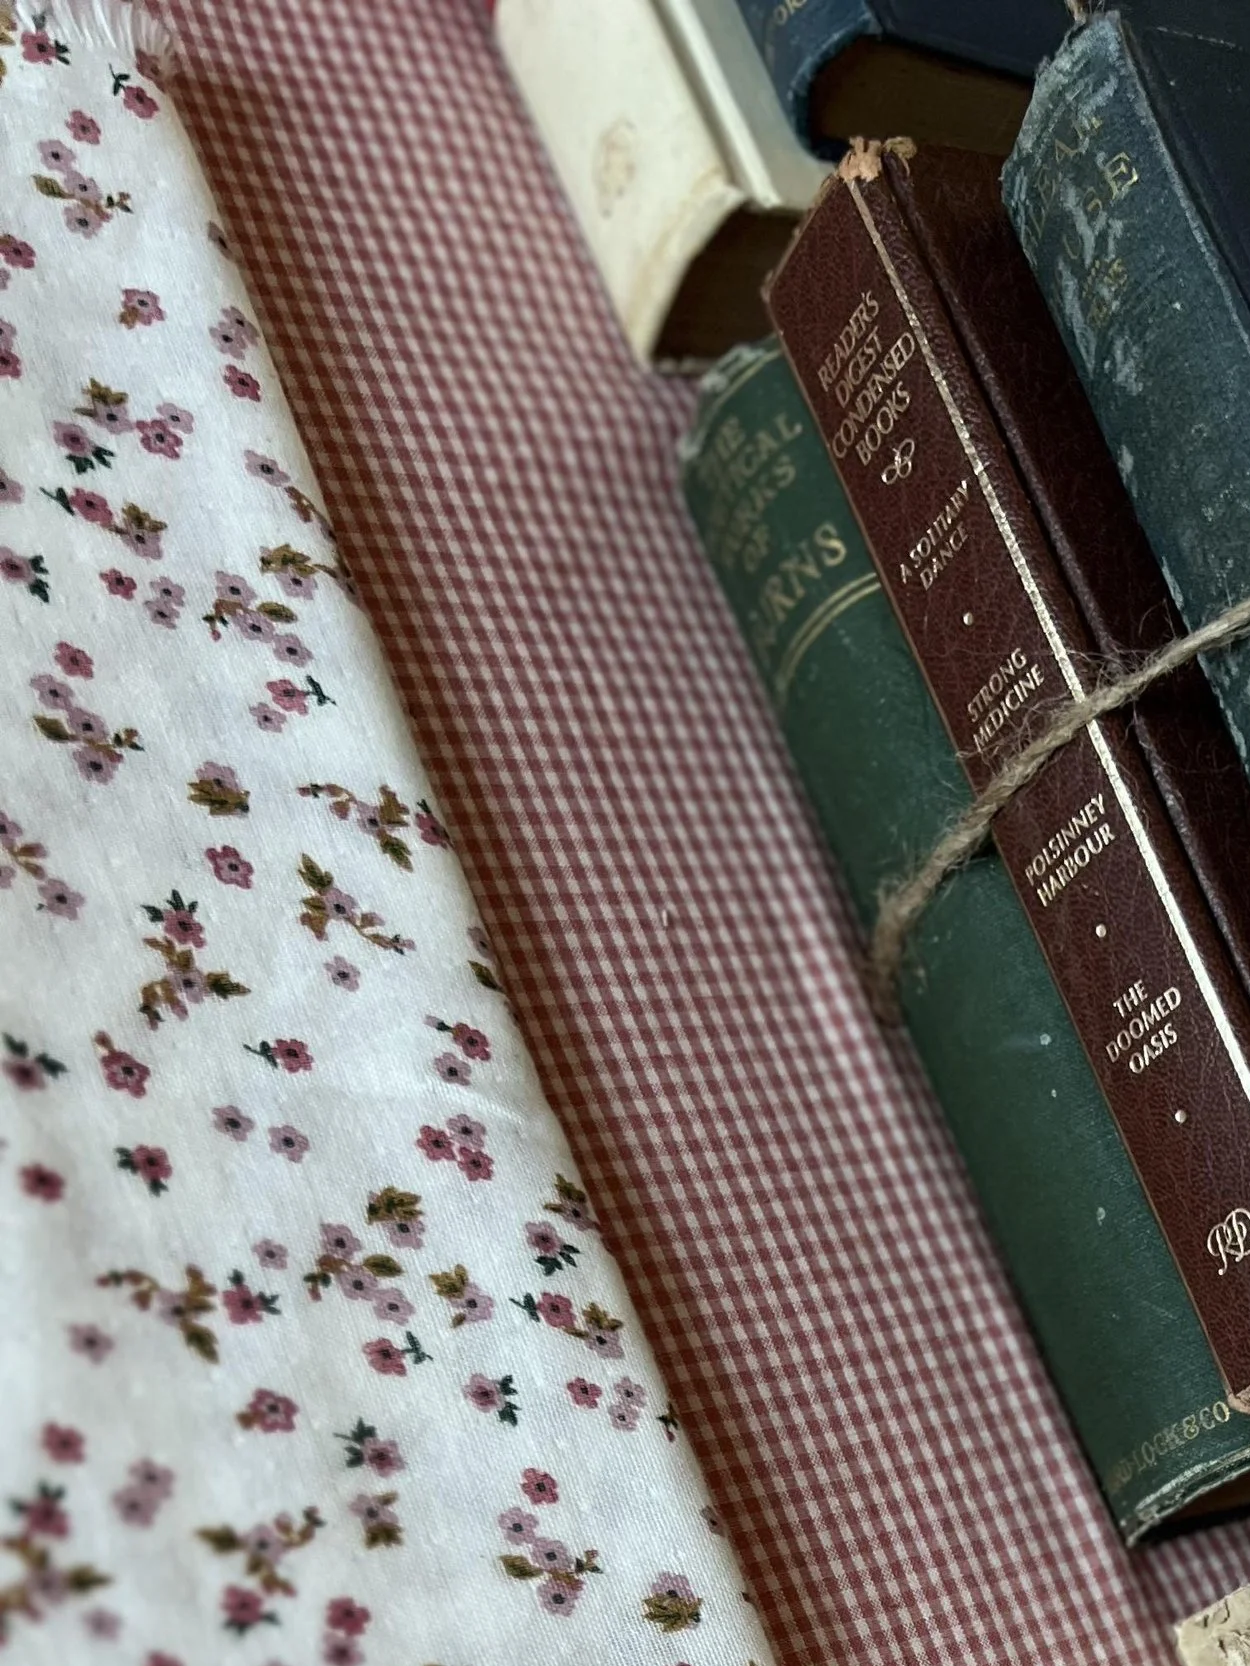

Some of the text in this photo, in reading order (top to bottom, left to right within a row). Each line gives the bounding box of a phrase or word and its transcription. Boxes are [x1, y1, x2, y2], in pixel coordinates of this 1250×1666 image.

[817, 290, 880, 392] READER'S
[834, 325, 882, 409] DIGEST
[832, 332, 915, 459] CONDENSED
[855, 381, 910, 466] BOOKS
[900, 563, 912, 584] A
[919, 521, 970, 590] DANCE
[967, 647, 1028, 722] STRONG
[973, 663, 1045, 753] MEDICINE
[1025, 793, 1107, 886] POLSINNEY
[1036, 823, 1116, 907] HARBOUR
[1105, 986, 1182, 1063] DOOMED
[1112, 979, 1148, 1018] THE
[1129, 1022, 1178, 1074] OASIS
